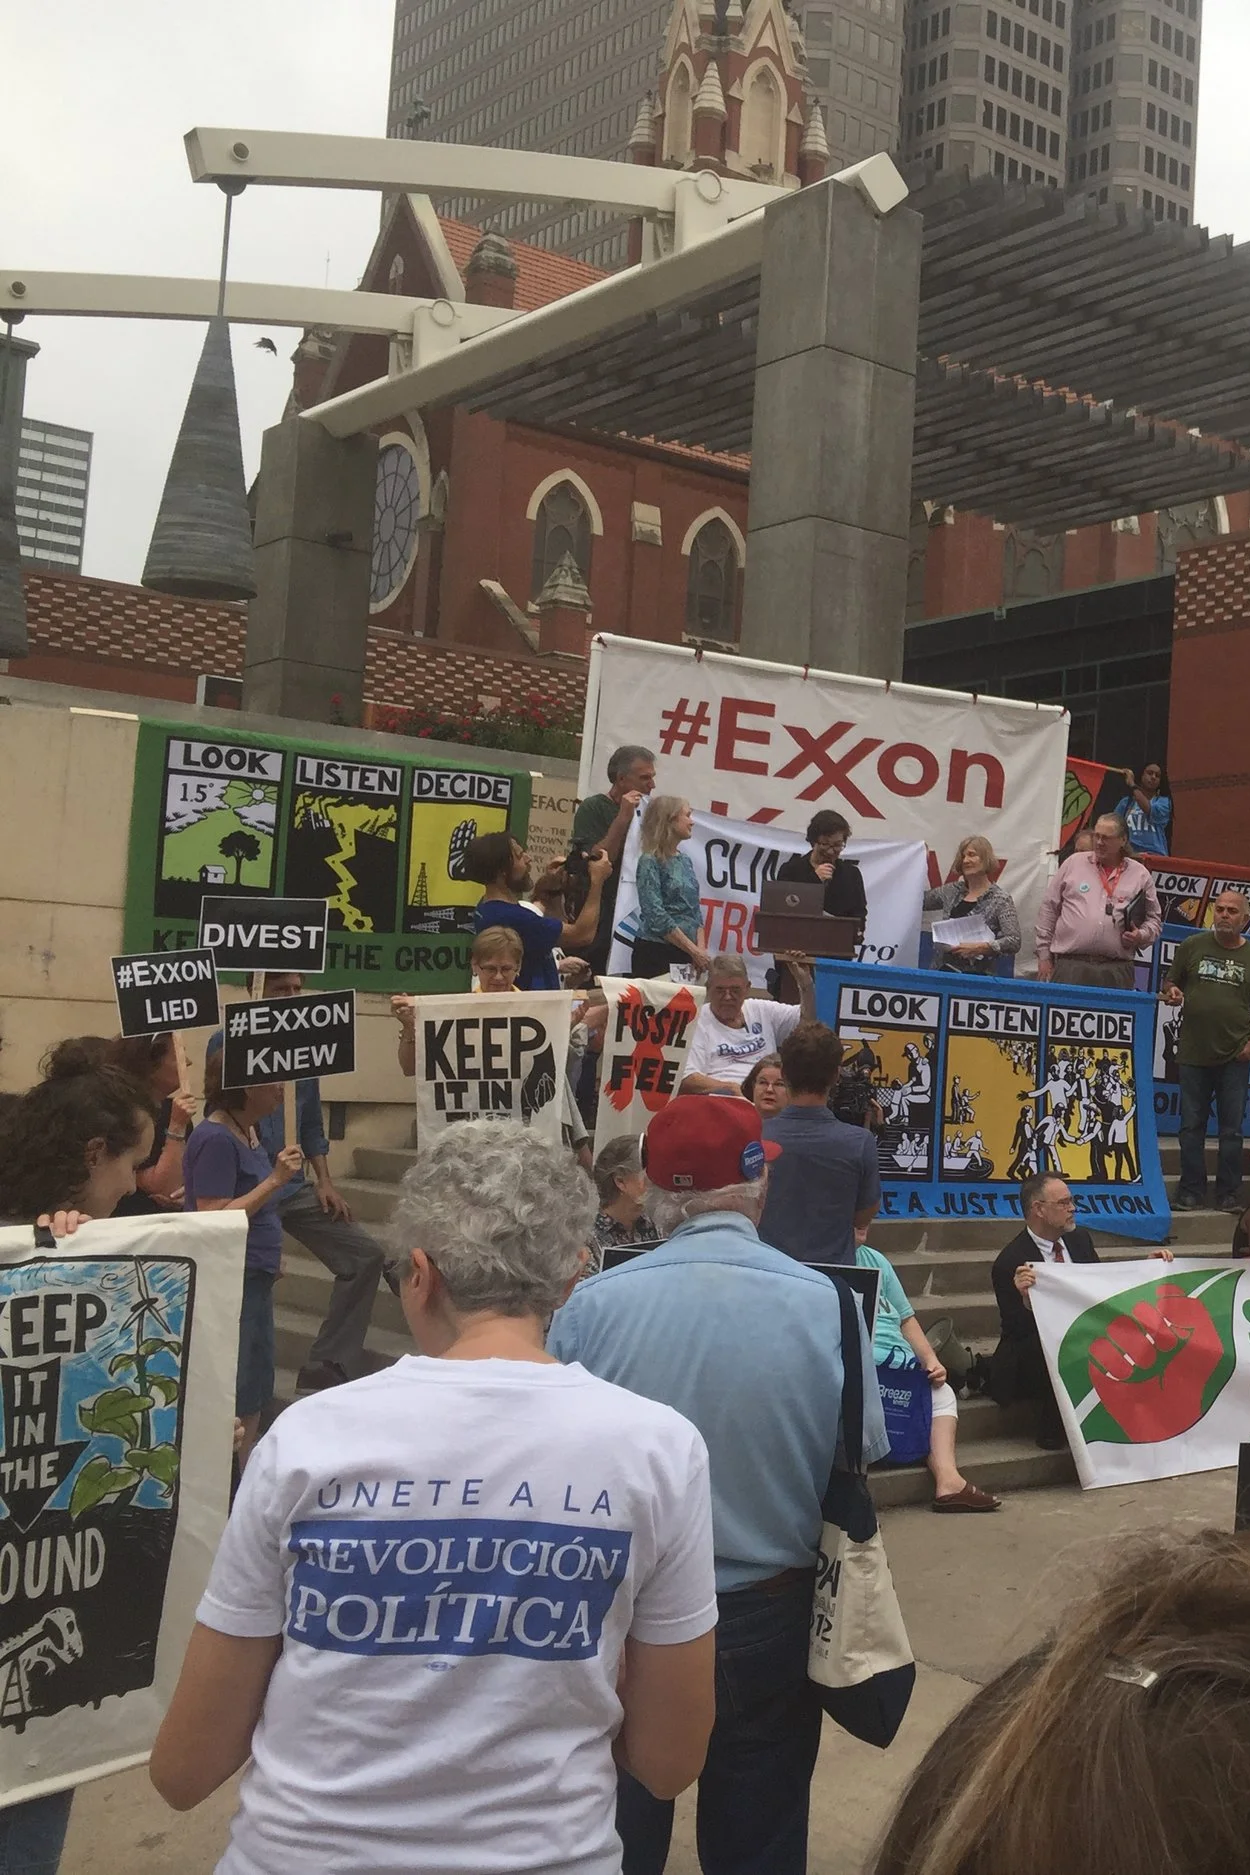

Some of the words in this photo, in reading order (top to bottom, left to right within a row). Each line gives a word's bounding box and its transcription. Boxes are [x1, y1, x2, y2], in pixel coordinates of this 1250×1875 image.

[183, 743, 270, 776] LOOK
[659, 697, 1006, 819] #Exxon
[300, 760, 398, 793] LISTEN
[416, 774, 510, 803] DECIDE
[531, 794, 582, 814] EFACT
[529, 835, 563, 846] NTOWN
[1155, 874, 1201, 893] LOOK
[152, 929, 200, 953] KE
[329, 943, 381, 971] THE
[395, 943, 472, 970] GROU
[203, 924, 323, 950] DIVEST
[117, 960, 212, 988] #EXXON
[146, 998, 198, 1023] LIED
[229, 1002, 349, 1037] #EXXON
[851, 993, 928, 1021] LOOK
[954, 1001, 1039, 1032] LISTEN
[1051, 1012, 1132, 1041] DECIDE
[247, 1043, 337, 1075] KNEW
[424, 1017, 546, 1081] KEEP
[434, 1081, 468, 1110] IT
[478, 1081, 512, 1110] IN
[1154, 1091, 1179, 1116] OI
[908, 1192, 928, 1215] A
[934, 1192, 999, 1215] JUST
[1003, 1193, 1156, 1215] TSITION
[0, 1293, 107, 1357] EEP
[14, 1371, 48, 1407] IT
[879, 1384, 912, 1400] Breeze
[12, 1412, 46, 1447] IN
[0, 1451, 59, 1494] THE
[318, 1478, 483, 1509] ÚNETE
[509, 1481, 534, 1507] A
[563, 1484, 612, 1517] LA
[0, 1527, 106, 1605] OUND
[298, 1536, 621, 1581] REVOLUCIÓN
[293, 1582, 593, 1650] POLÍTICA
